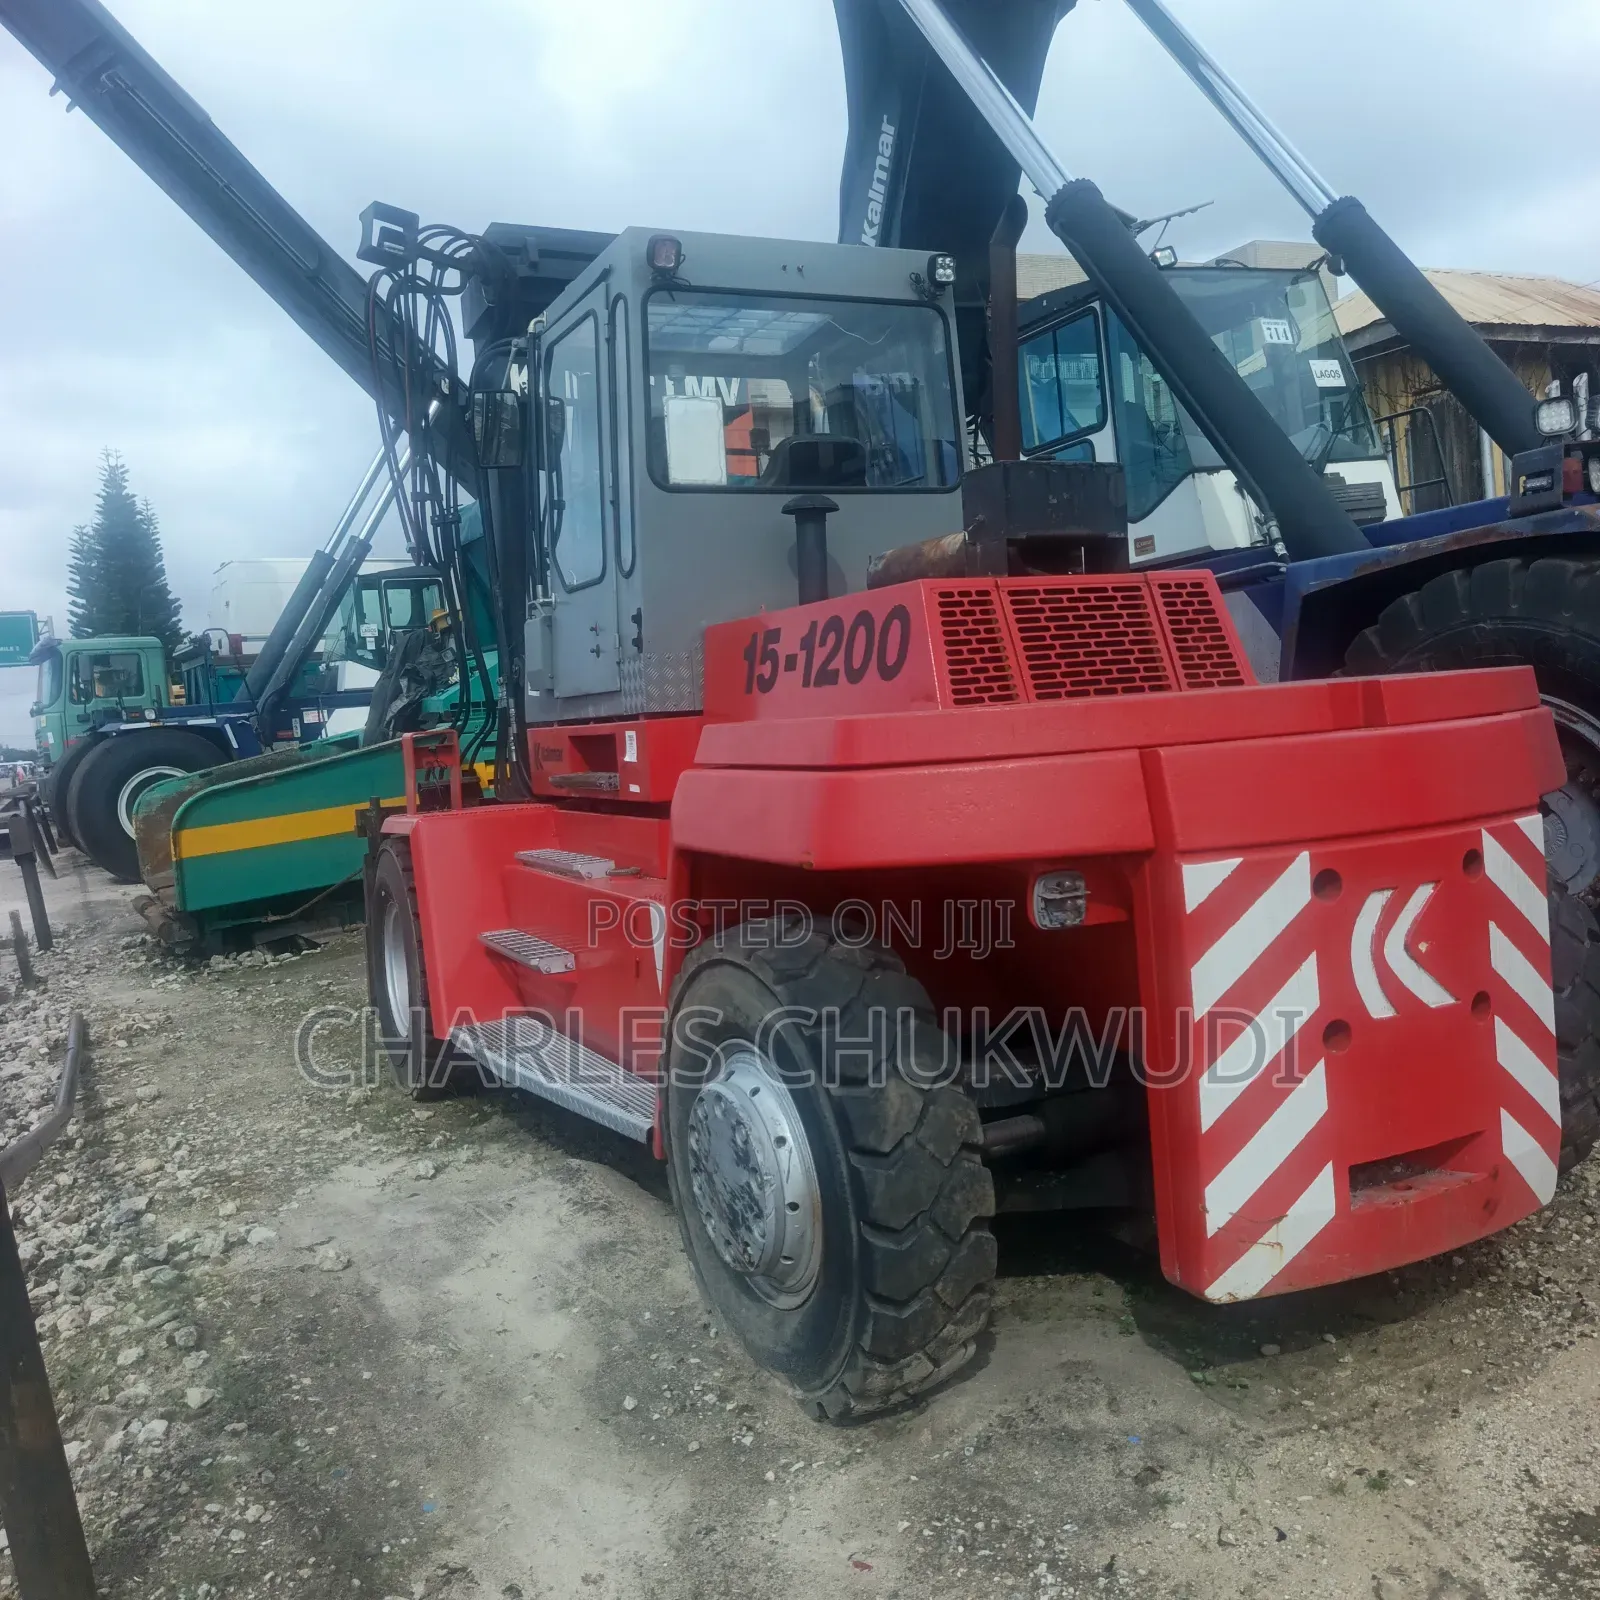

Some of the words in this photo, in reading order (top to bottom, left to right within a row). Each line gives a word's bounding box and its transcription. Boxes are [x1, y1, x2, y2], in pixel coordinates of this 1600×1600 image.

[861, 114, 895, 247] Kalmar
[1266, 327, 1289, 341] 714
[1314, 369, 1341, 379] LAGOS
[744, 604, 911, 694] 15-1200
